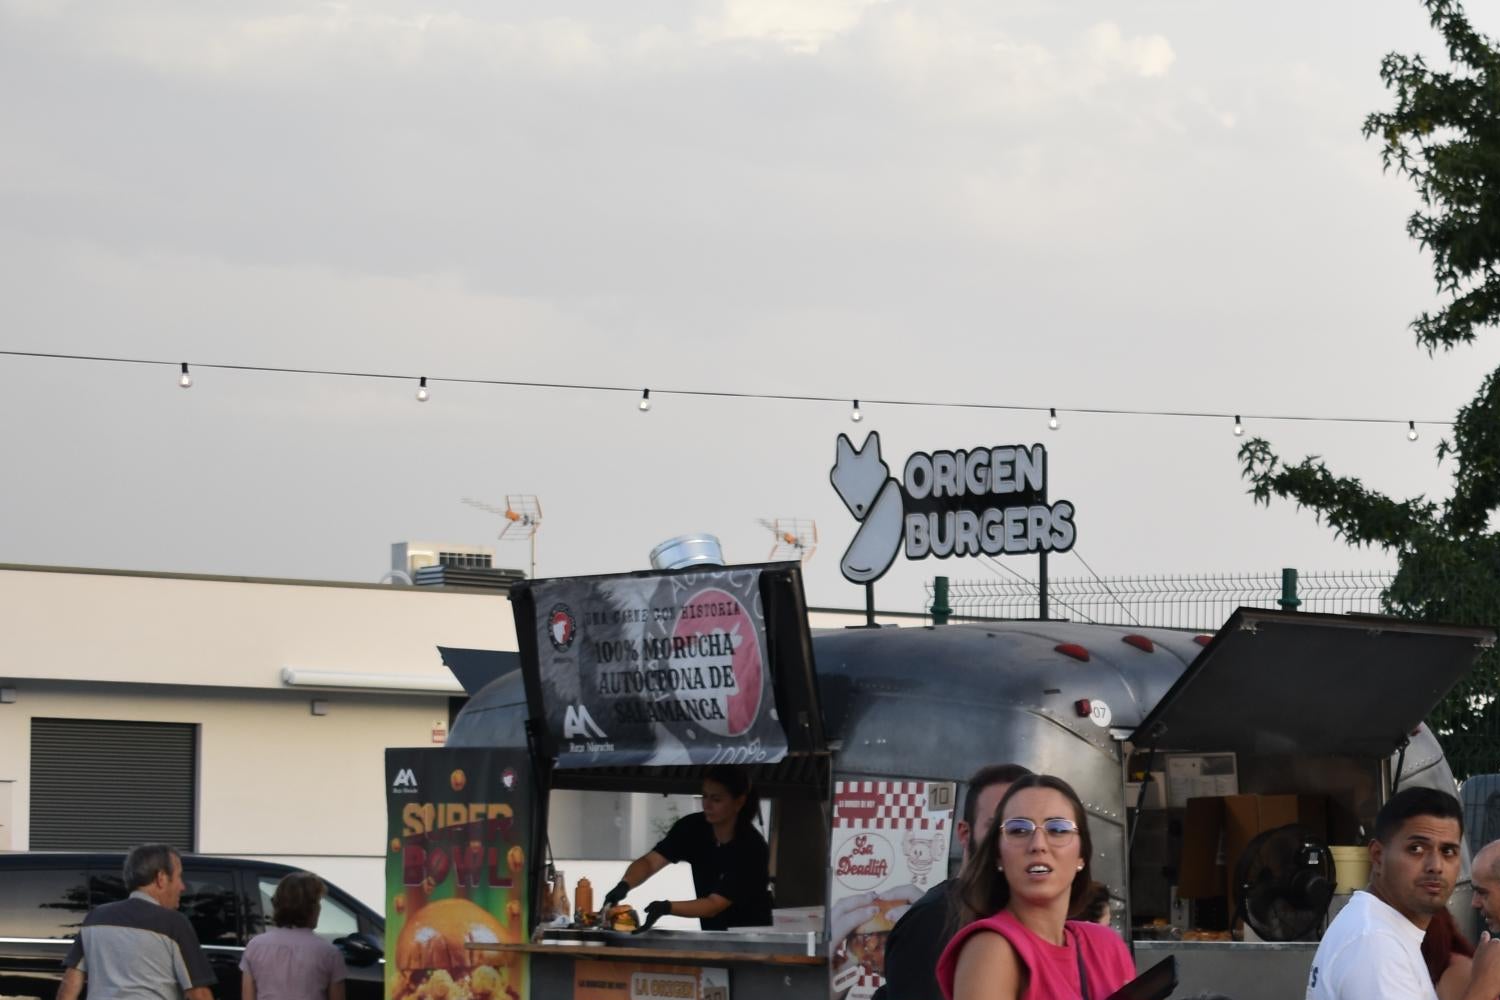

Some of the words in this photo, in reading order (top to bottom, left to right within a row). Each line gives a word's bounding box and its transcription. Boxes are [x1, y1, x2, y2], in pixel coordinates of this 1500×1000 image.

[904, 443, 1046, 499] ORIGEN
[905, 500, 1076, 560] BURGERS
[584, 611, 606, 626] UNA
[614, 608, 649, 624] CARNE
[653, 606, 675, 621] CON
[681, 601, 741, 619] HISTORIA
[595, 641, 639, 663] 100%
[644, 633, 736, 660] MORUCHA
[710, 665, 735, 689] DE
[614, 698, 725, 723] SALAMANCA
[931, 787, 949, 805] 10
[402, 803, 513, 840] SUPER
[402, 846, 513, 887] BOWL
[837, 855, 888, 877] Deadlift
[635, 977, 648, 996] LA
[650, 979, 696, 998] ORIGEN
